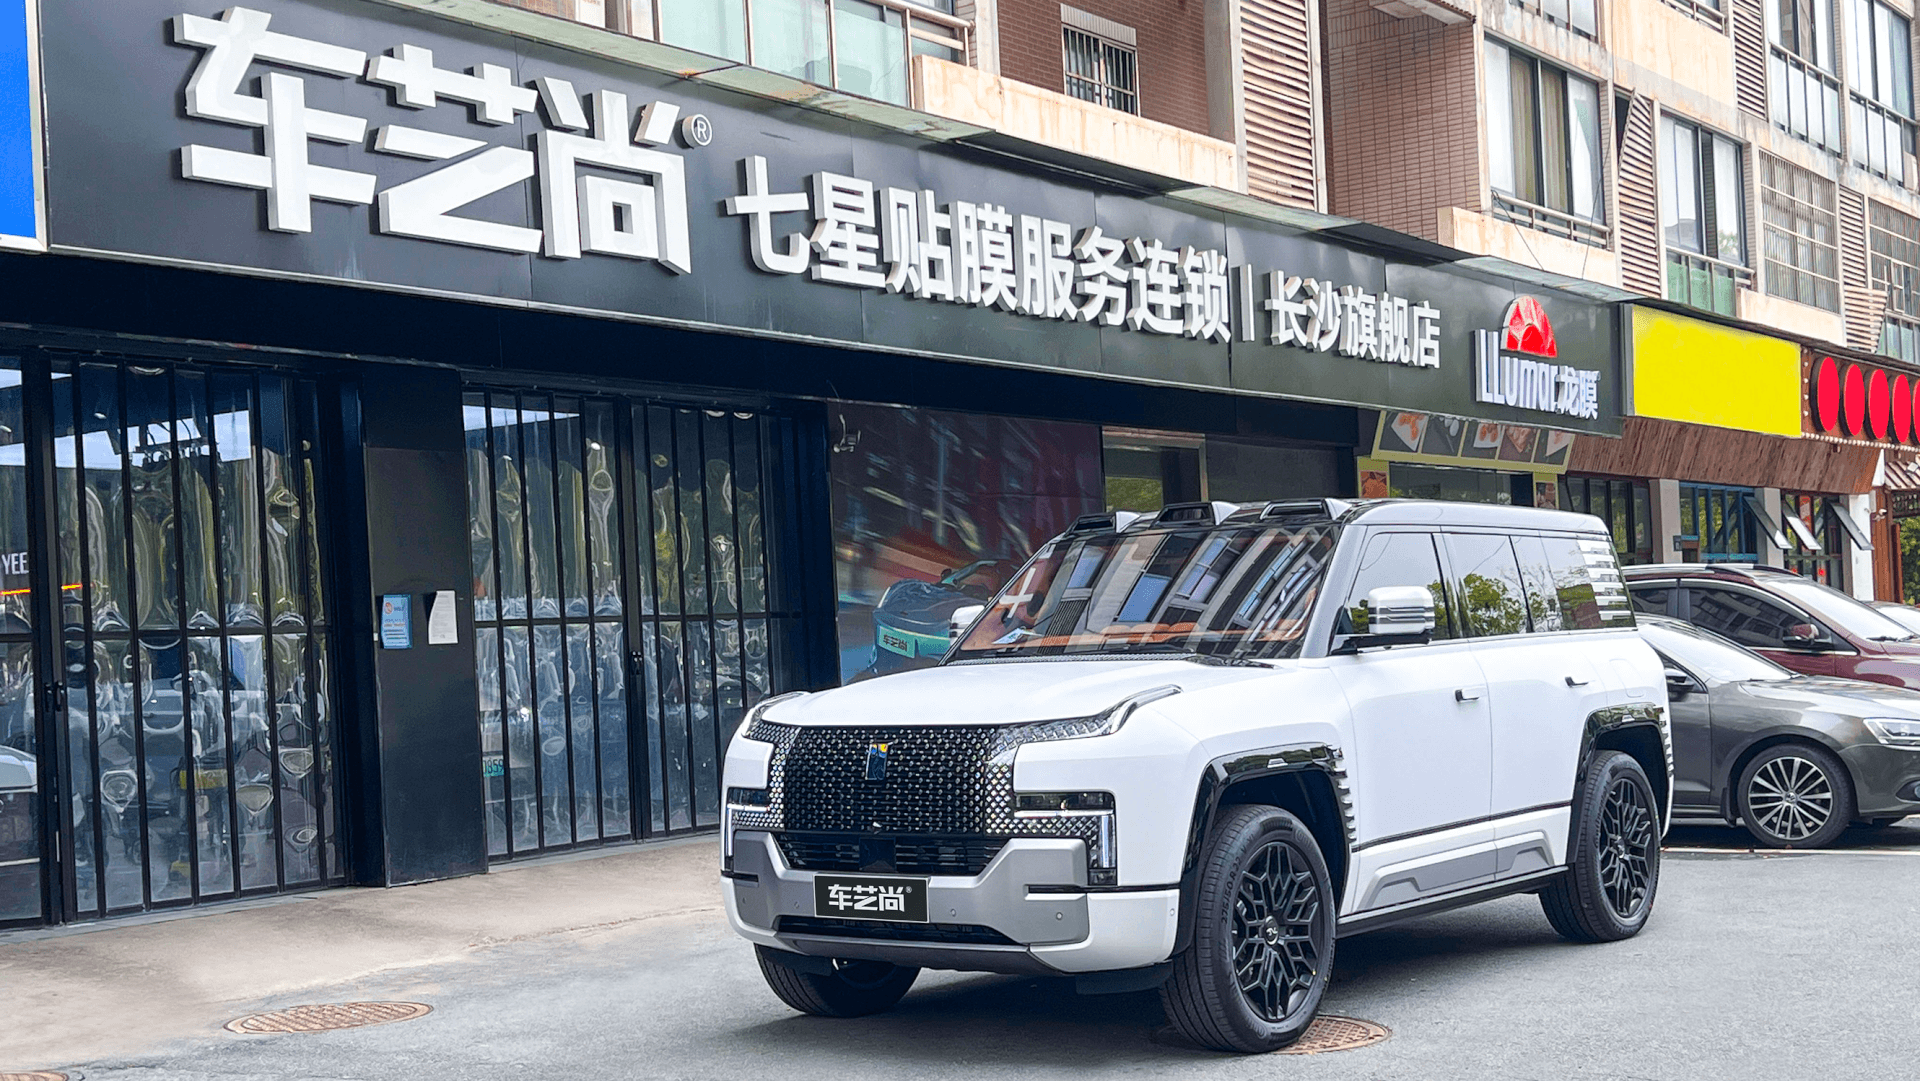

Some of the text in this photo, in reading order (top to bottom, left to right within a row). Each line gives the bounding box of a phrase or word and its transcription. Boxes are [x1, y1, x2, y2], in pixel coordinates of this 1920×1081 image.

[173, 6, 691, 275] 车艺尚
[726, 155, 1440, 369] 七星贴膜服务连锁 长沙旗舰店
[1556, 365, 1599, 420] 龙膜
[828, 884, 905, 912] 车艺尚
